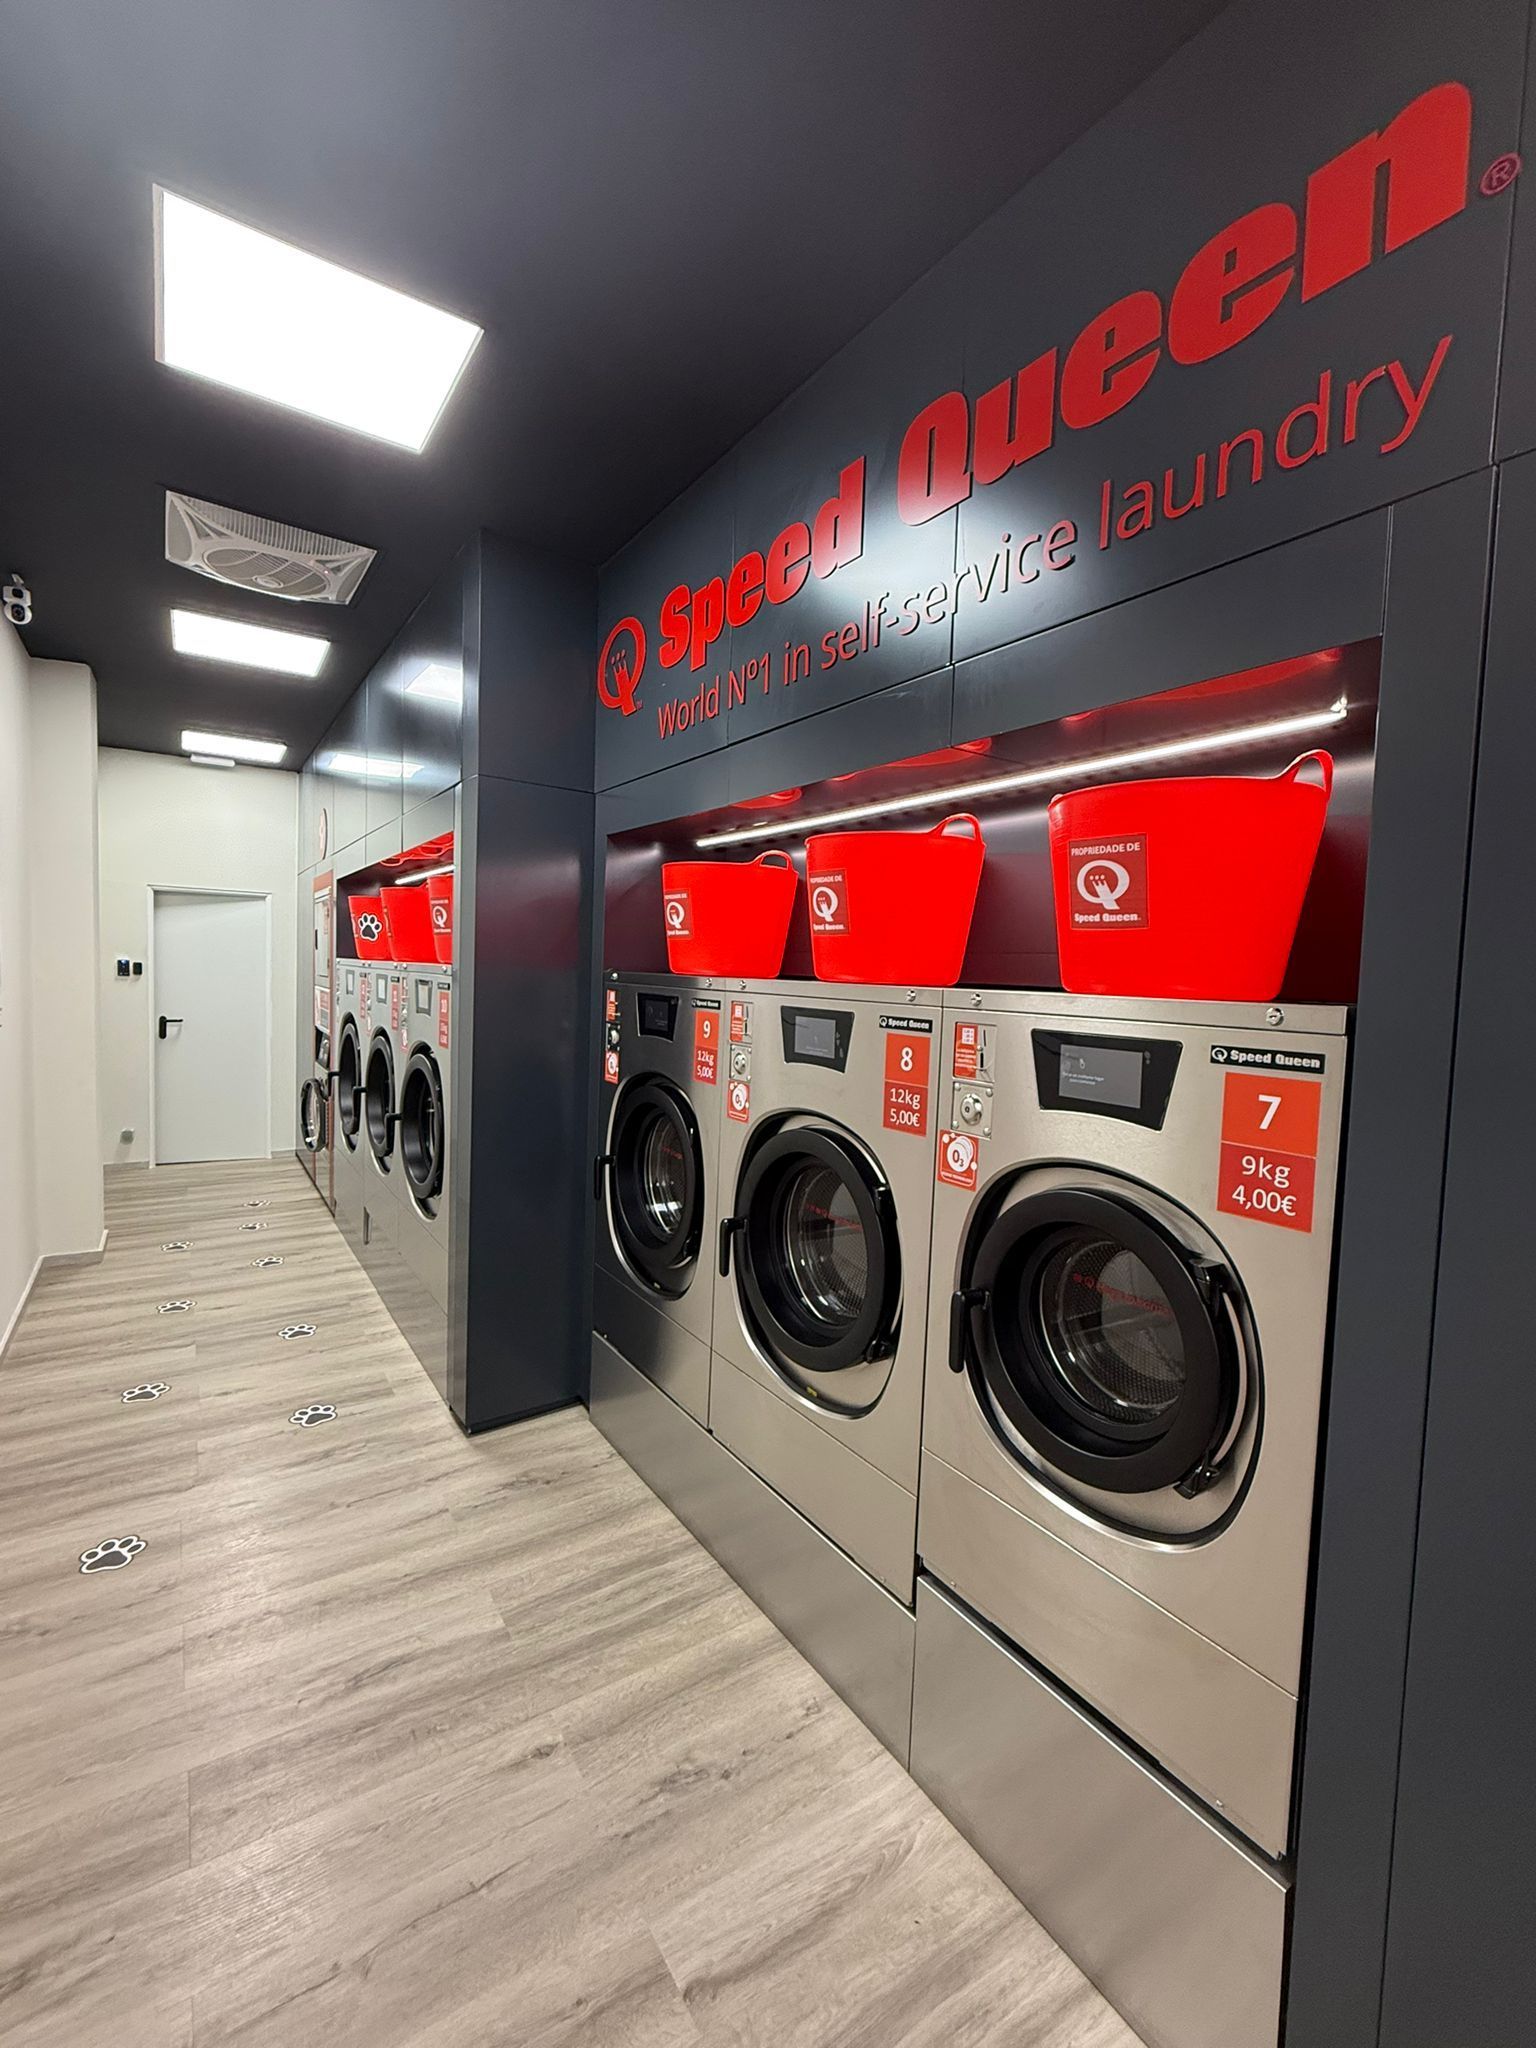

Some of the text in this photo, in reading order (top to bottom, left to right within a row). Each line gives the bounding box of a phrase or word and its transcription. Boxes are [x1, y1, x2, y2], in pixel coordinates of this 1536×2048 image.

[657, 674, 721, 740] World
[783, 641, 811, 686] in
[820, 519, 1079, 670] self-service
[1099, 333, 1454, 551] laundry
[659, 455, 867, 672] Speed
[1071, 841, 1141, 856] PROPRIEDADE DE
[1074, 912, 1100, 924] Speed
[703, 1020, 711, 1039] 9
[888, 1017, 908, 1029] Speed
[909, 1019, 930, 1030] Queen
[697, 1050, 715, 1067] 12kg
[900, 1046, 913, 1072] 8
[1230, 1049, 1272, 1065] Speed
[1275, 1053, 1321, 1069] Queen
[890, 1088, 921, 1110] 12kg
[889, 1109, 921, 1127] 5,00€
[1258, 1094, 1282, 1130] 7
[1241, 1155, 1291, 1189] 9kg
[1232, 1185, 1297, 1216] 4,00€
